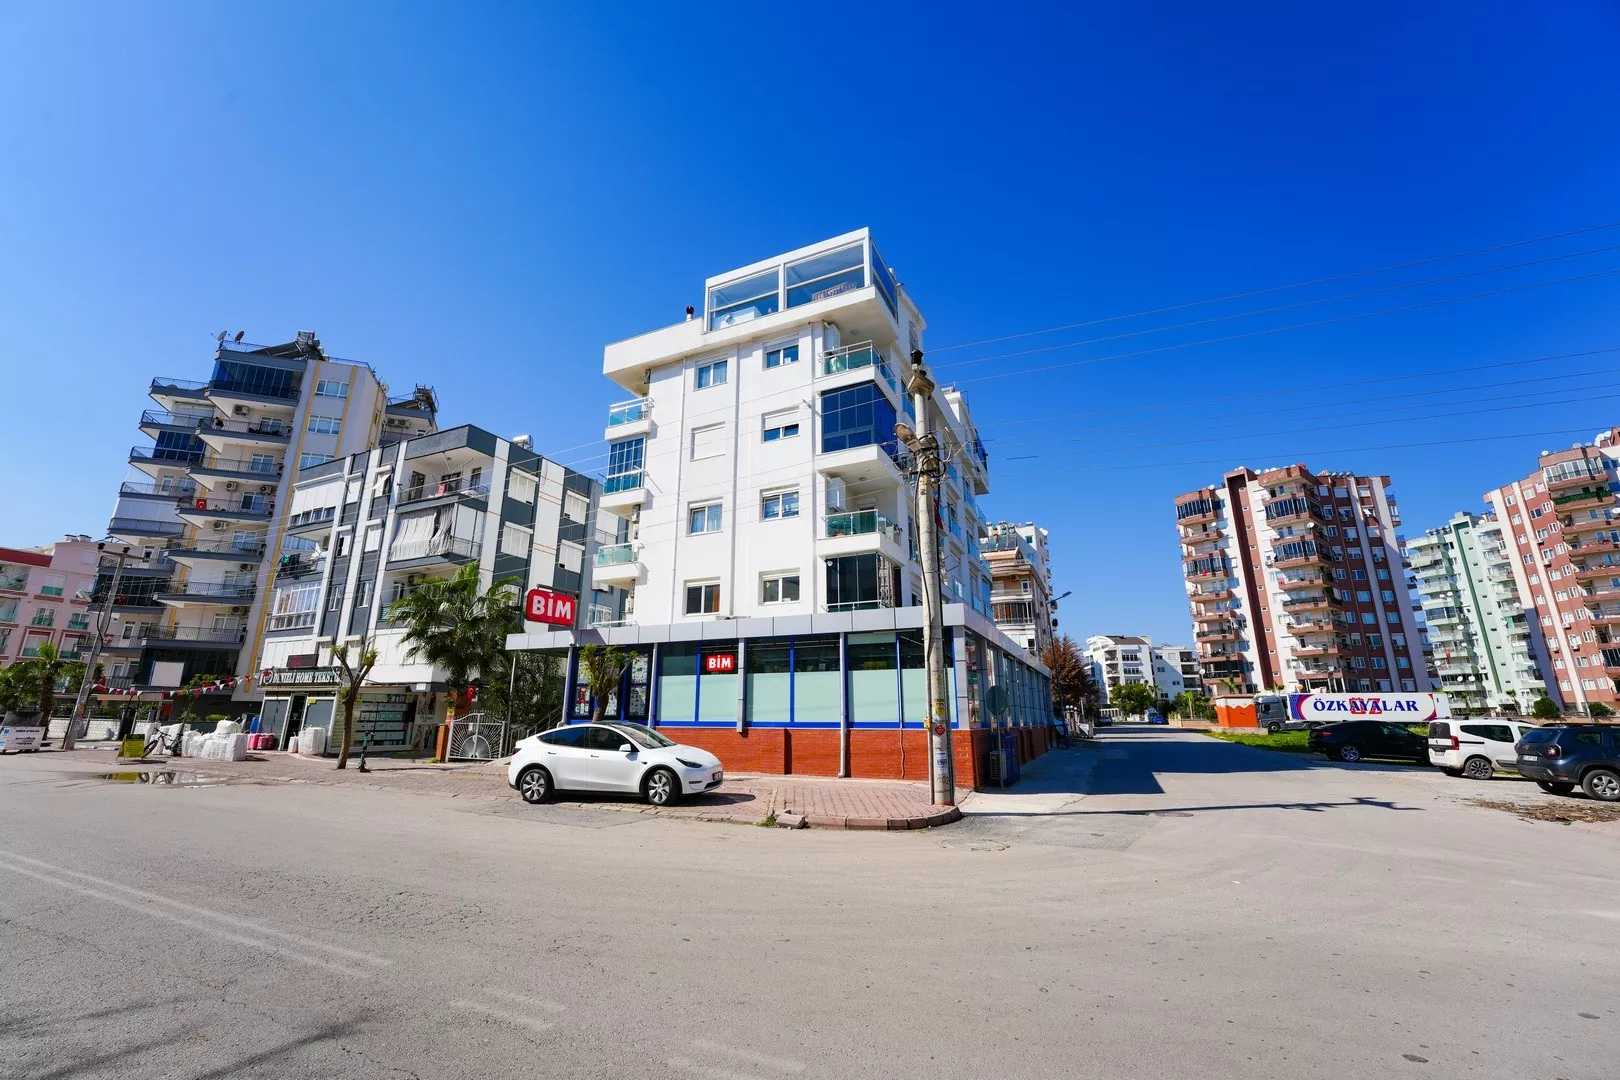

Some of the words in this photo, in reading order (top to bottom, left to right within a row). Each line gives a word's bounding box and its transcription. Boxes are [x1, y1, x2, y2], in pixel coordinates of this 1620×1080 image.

[532, 593, 571, 620] BİM
[708, 655, 731, 669] BİM
[295, 671, 314, 683] HOME
[1313, 698, 1419, 712] ÖZKAYALAR
